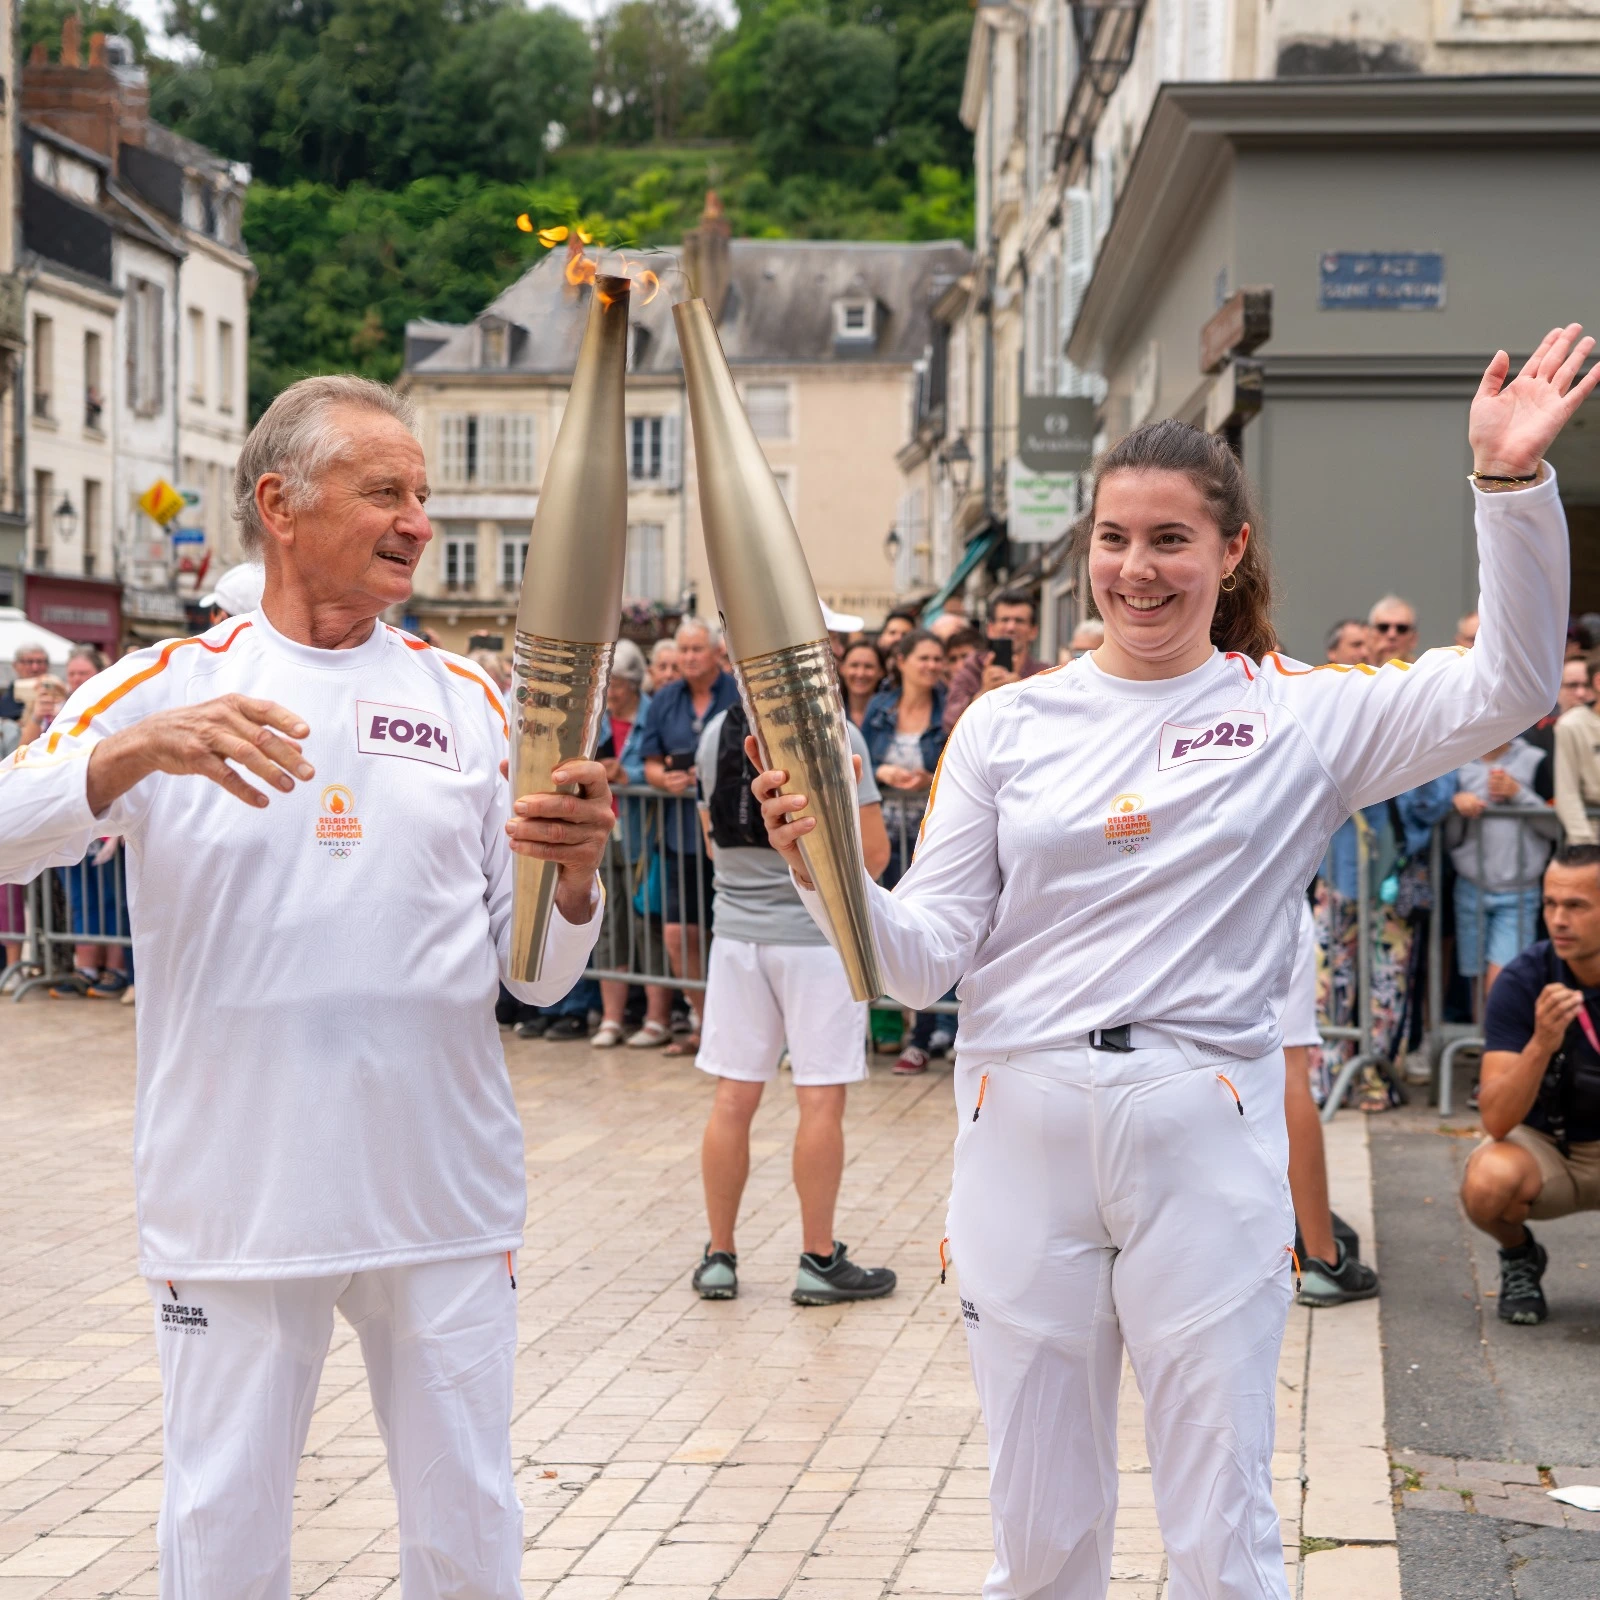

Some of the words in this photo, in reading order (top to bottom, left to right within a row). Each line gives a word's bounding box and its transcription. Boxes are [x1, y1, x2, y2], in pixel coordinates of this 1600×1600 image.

[1107, 815, 1135, 824] RELAIS
[1104, 824, 1115, 832] LA
[1116, 821, 1151, 830] FLAMME
[1105, 828, 1151, 839] OLYMPIQUE
[162, 1303, 189, 1315] RELAIS
[191, 1307, 204, 1317] DE
[161, 1313, 170, 1323] LA
[172, 1315, 208, 1327] FLAMME
